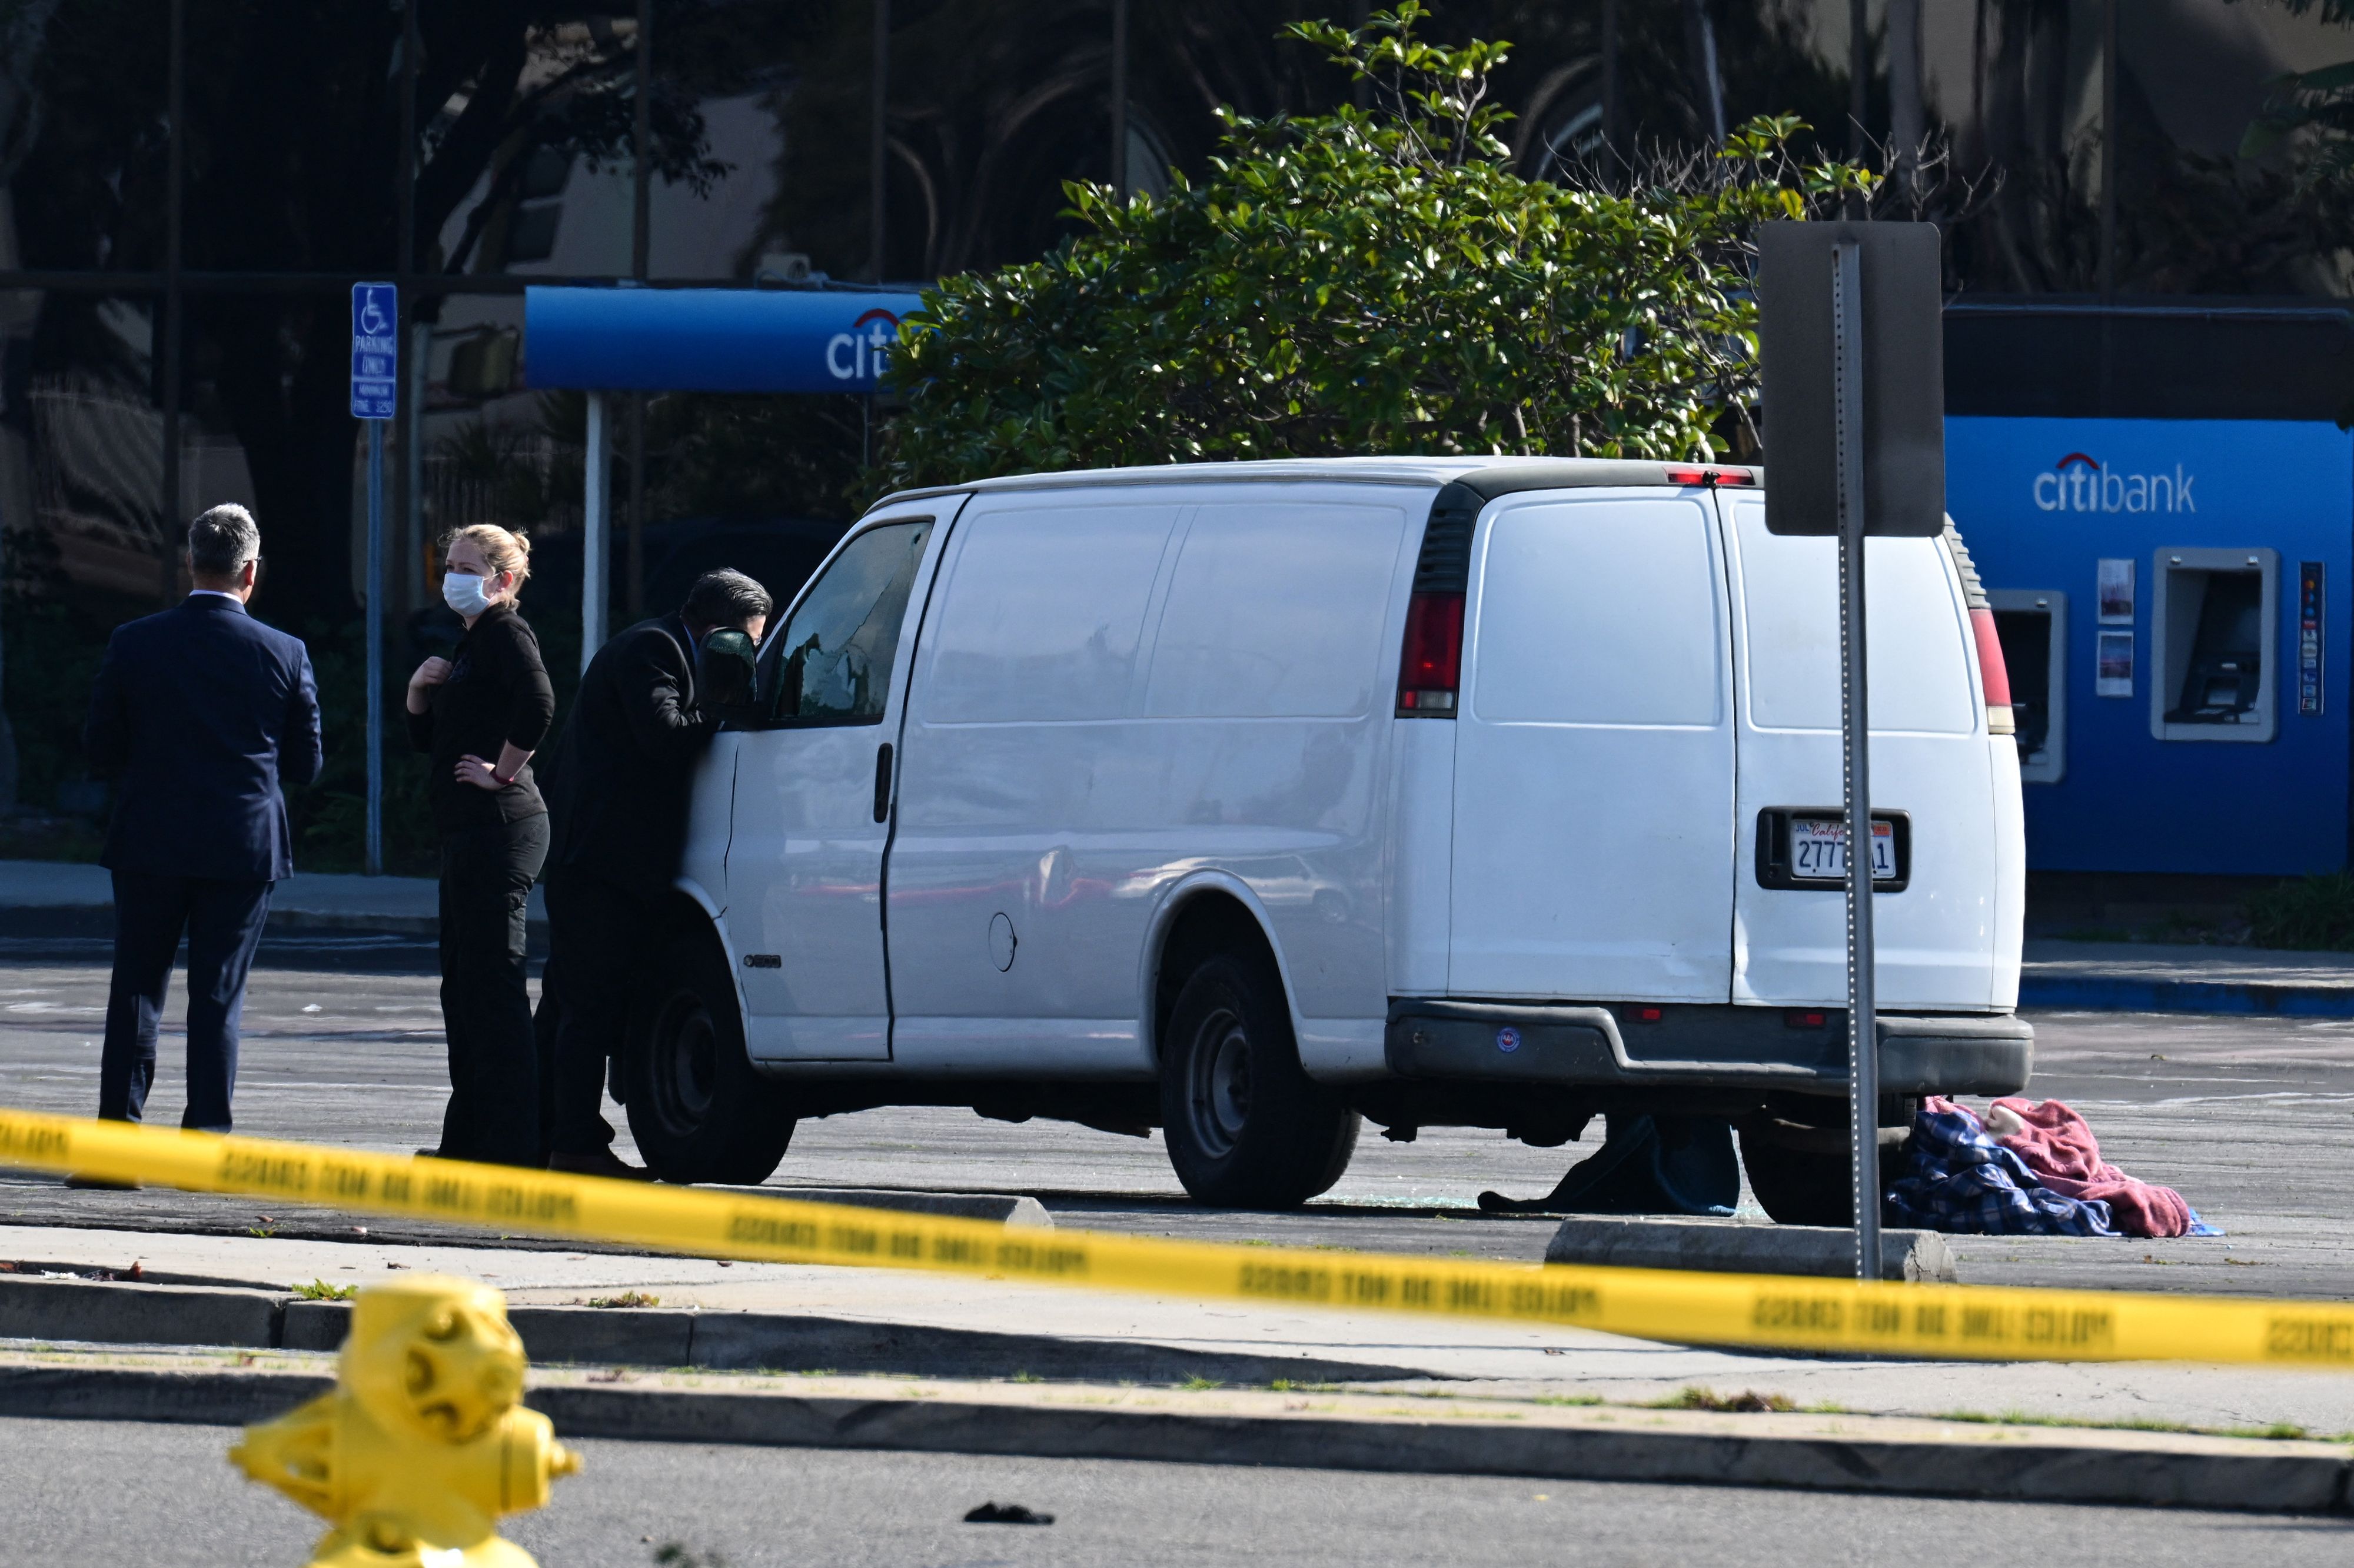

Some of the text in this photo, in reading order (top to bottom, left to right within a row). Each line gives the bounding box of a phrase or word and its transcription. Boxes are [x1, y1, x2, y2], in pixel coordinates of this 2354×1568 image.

[827, 323, 899, 379] cit
[2034, 461, 2196, 512] citibank
[1811, 823, 1845, 841] Califo
